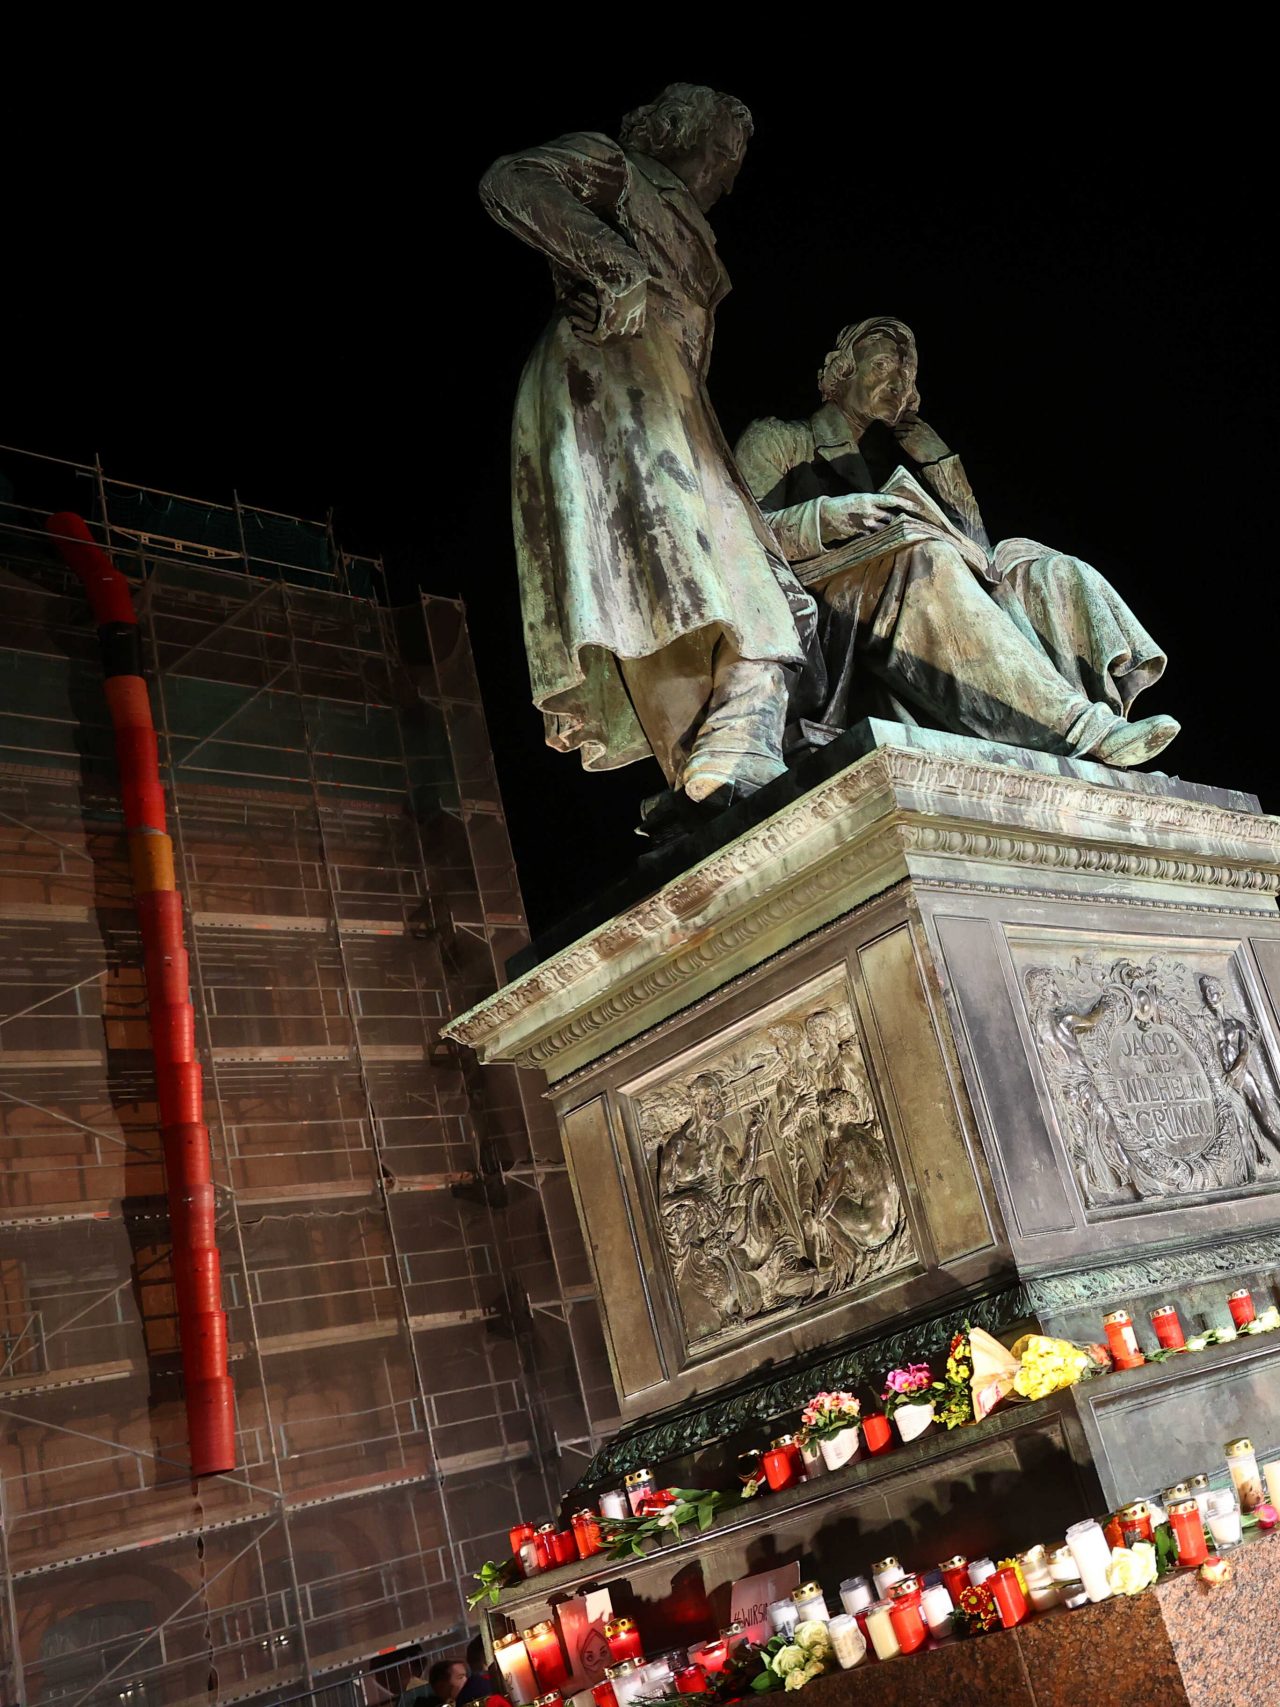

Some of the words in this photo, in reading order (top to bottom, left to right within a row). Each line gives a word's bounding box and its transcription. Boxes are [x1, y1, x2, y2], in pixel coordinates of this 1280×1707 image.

[1121, 1032, 1179, 1056] JACOB
[1119, 1073, 1211, 1103] WILHELM
[1136, 1102, 1214, 1146] GRIMM
